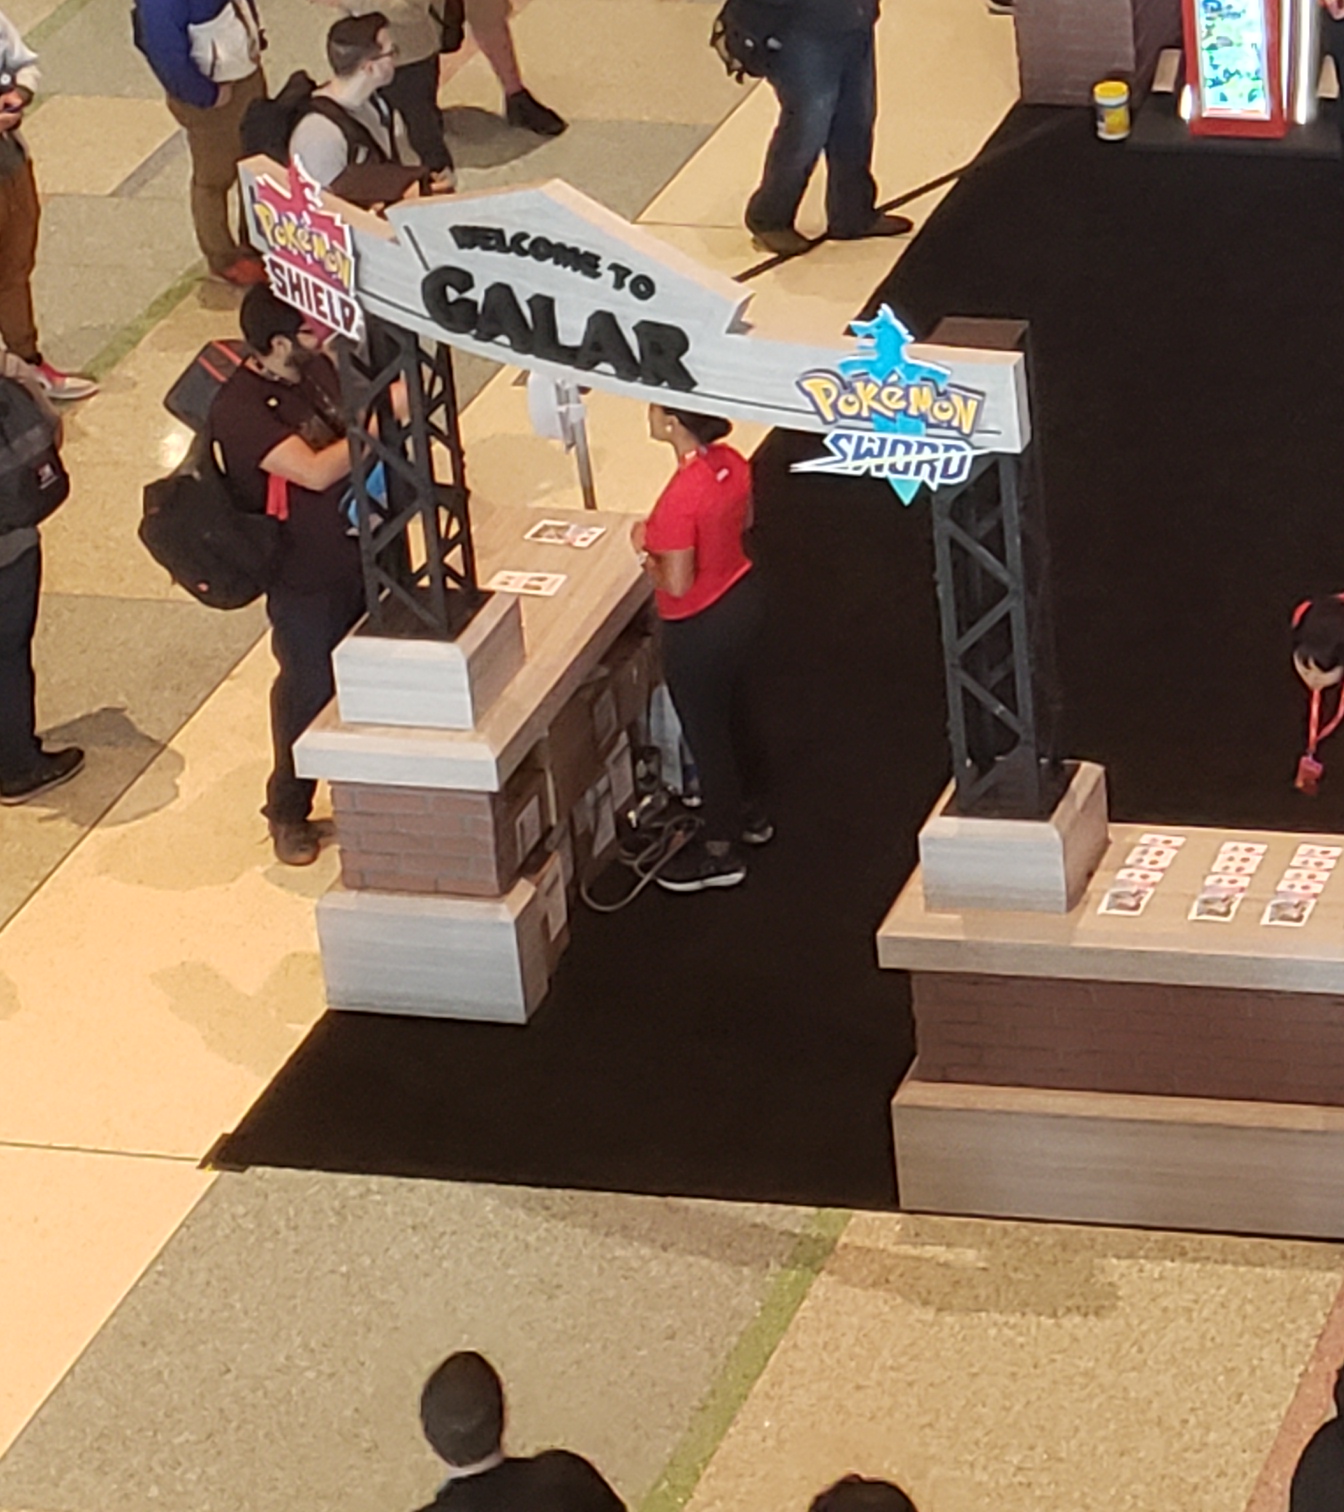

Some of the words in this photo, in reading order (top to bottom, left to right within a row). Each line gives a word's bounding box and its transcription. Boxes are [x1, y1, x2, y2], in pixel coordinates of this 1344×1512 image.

[268, 256, 358, 335] SHIELD
[449, 225, 602, 280] WELCOME
[607, 262, 656, 301] TO
[421, 265, 698, 392] GALAR
[822, 433, 969, 485] SWORD
